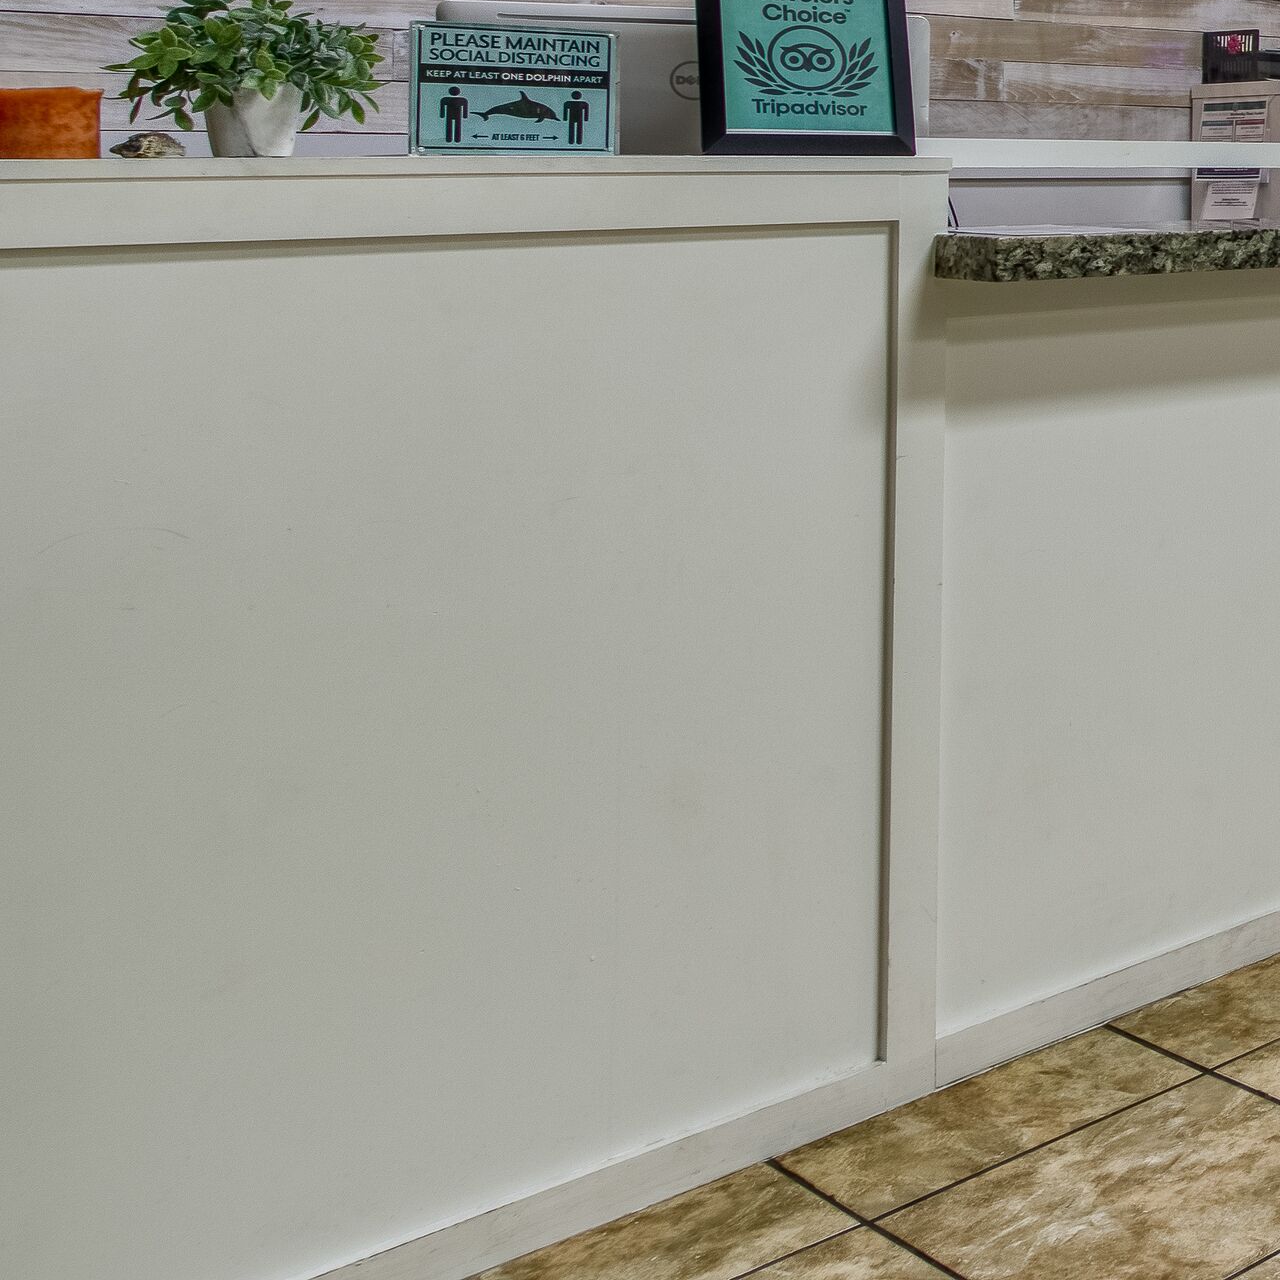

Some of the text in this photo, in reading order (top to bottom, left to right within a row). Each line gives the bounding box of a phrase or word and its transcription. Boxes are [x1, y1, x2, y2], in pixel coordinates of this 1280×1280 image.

[430, 32, 600, 54] PLEASE MAINTAIN
[429, 48, 601, 67] SOCIAL DISTANCING
[426, 70, 452, 78] KEEP
[469, 72, 500, 80] LEAST
[501, 73, 524, 81] ONE
[526, 74, 571, 82] DOLPHIN
[751, 99, 868, 117] Tripadvisor
